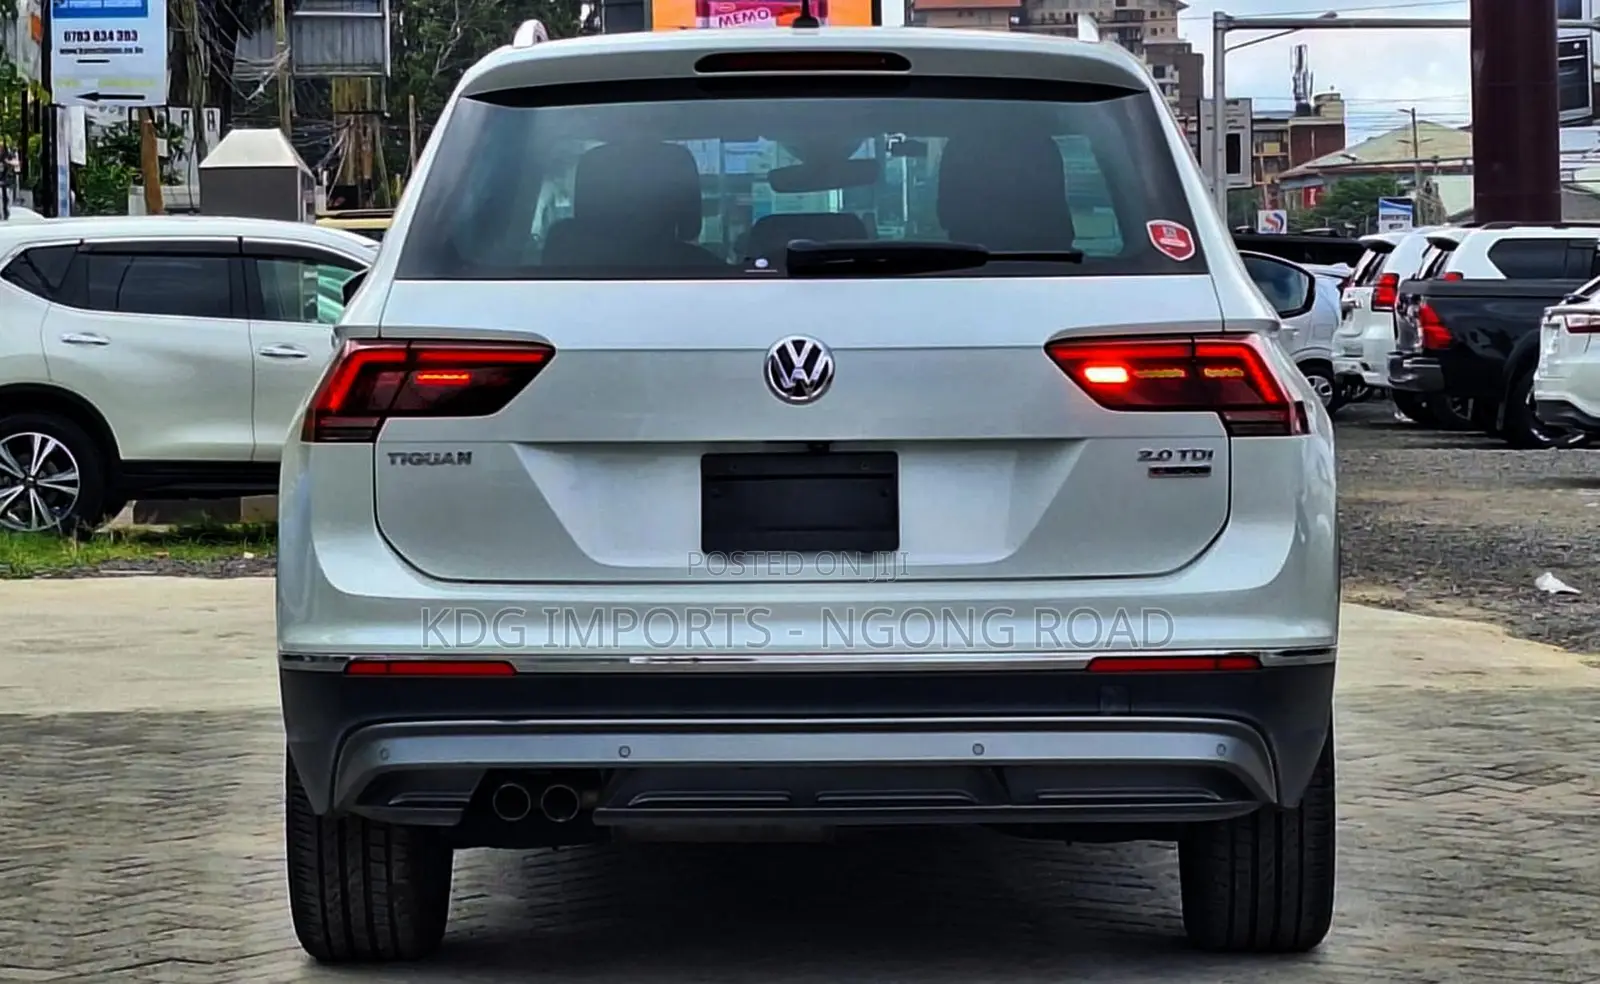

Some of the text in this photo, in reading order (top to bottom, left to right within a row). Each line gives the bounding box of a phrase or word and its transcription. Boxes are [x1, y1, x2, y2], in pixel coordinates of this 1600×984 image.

[719, 9, 770, 28] MEMO
[387, 451, 473, 466] TIGUAN
[1136, 449, 1215, 462] 2.0 TDI
